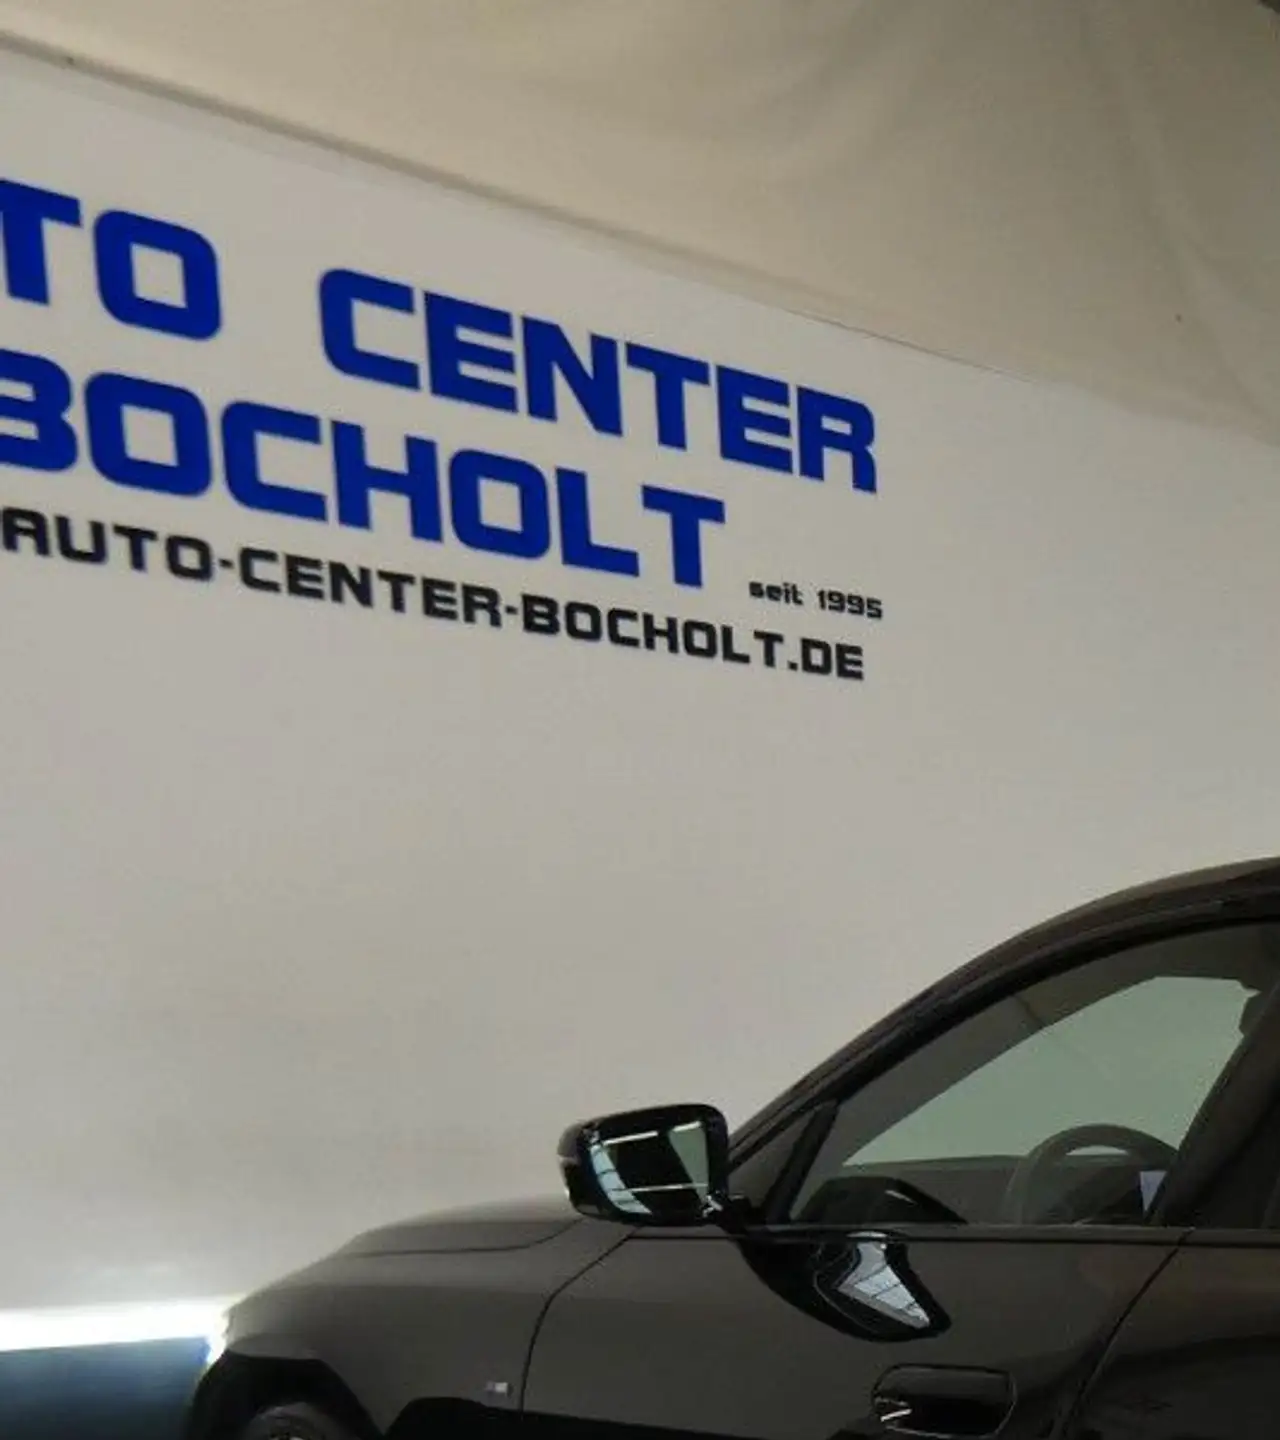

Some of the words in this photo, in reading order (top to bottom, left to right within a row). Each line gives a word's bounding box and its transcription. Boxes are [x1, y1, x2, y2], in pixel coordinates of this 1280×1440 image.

[0, 348, 726, 588] BOCHOLT
[749, 580, 804, 606] seit
[816, 588, 883, 620] 1995
[319, 268, 878, 494] CENTER
